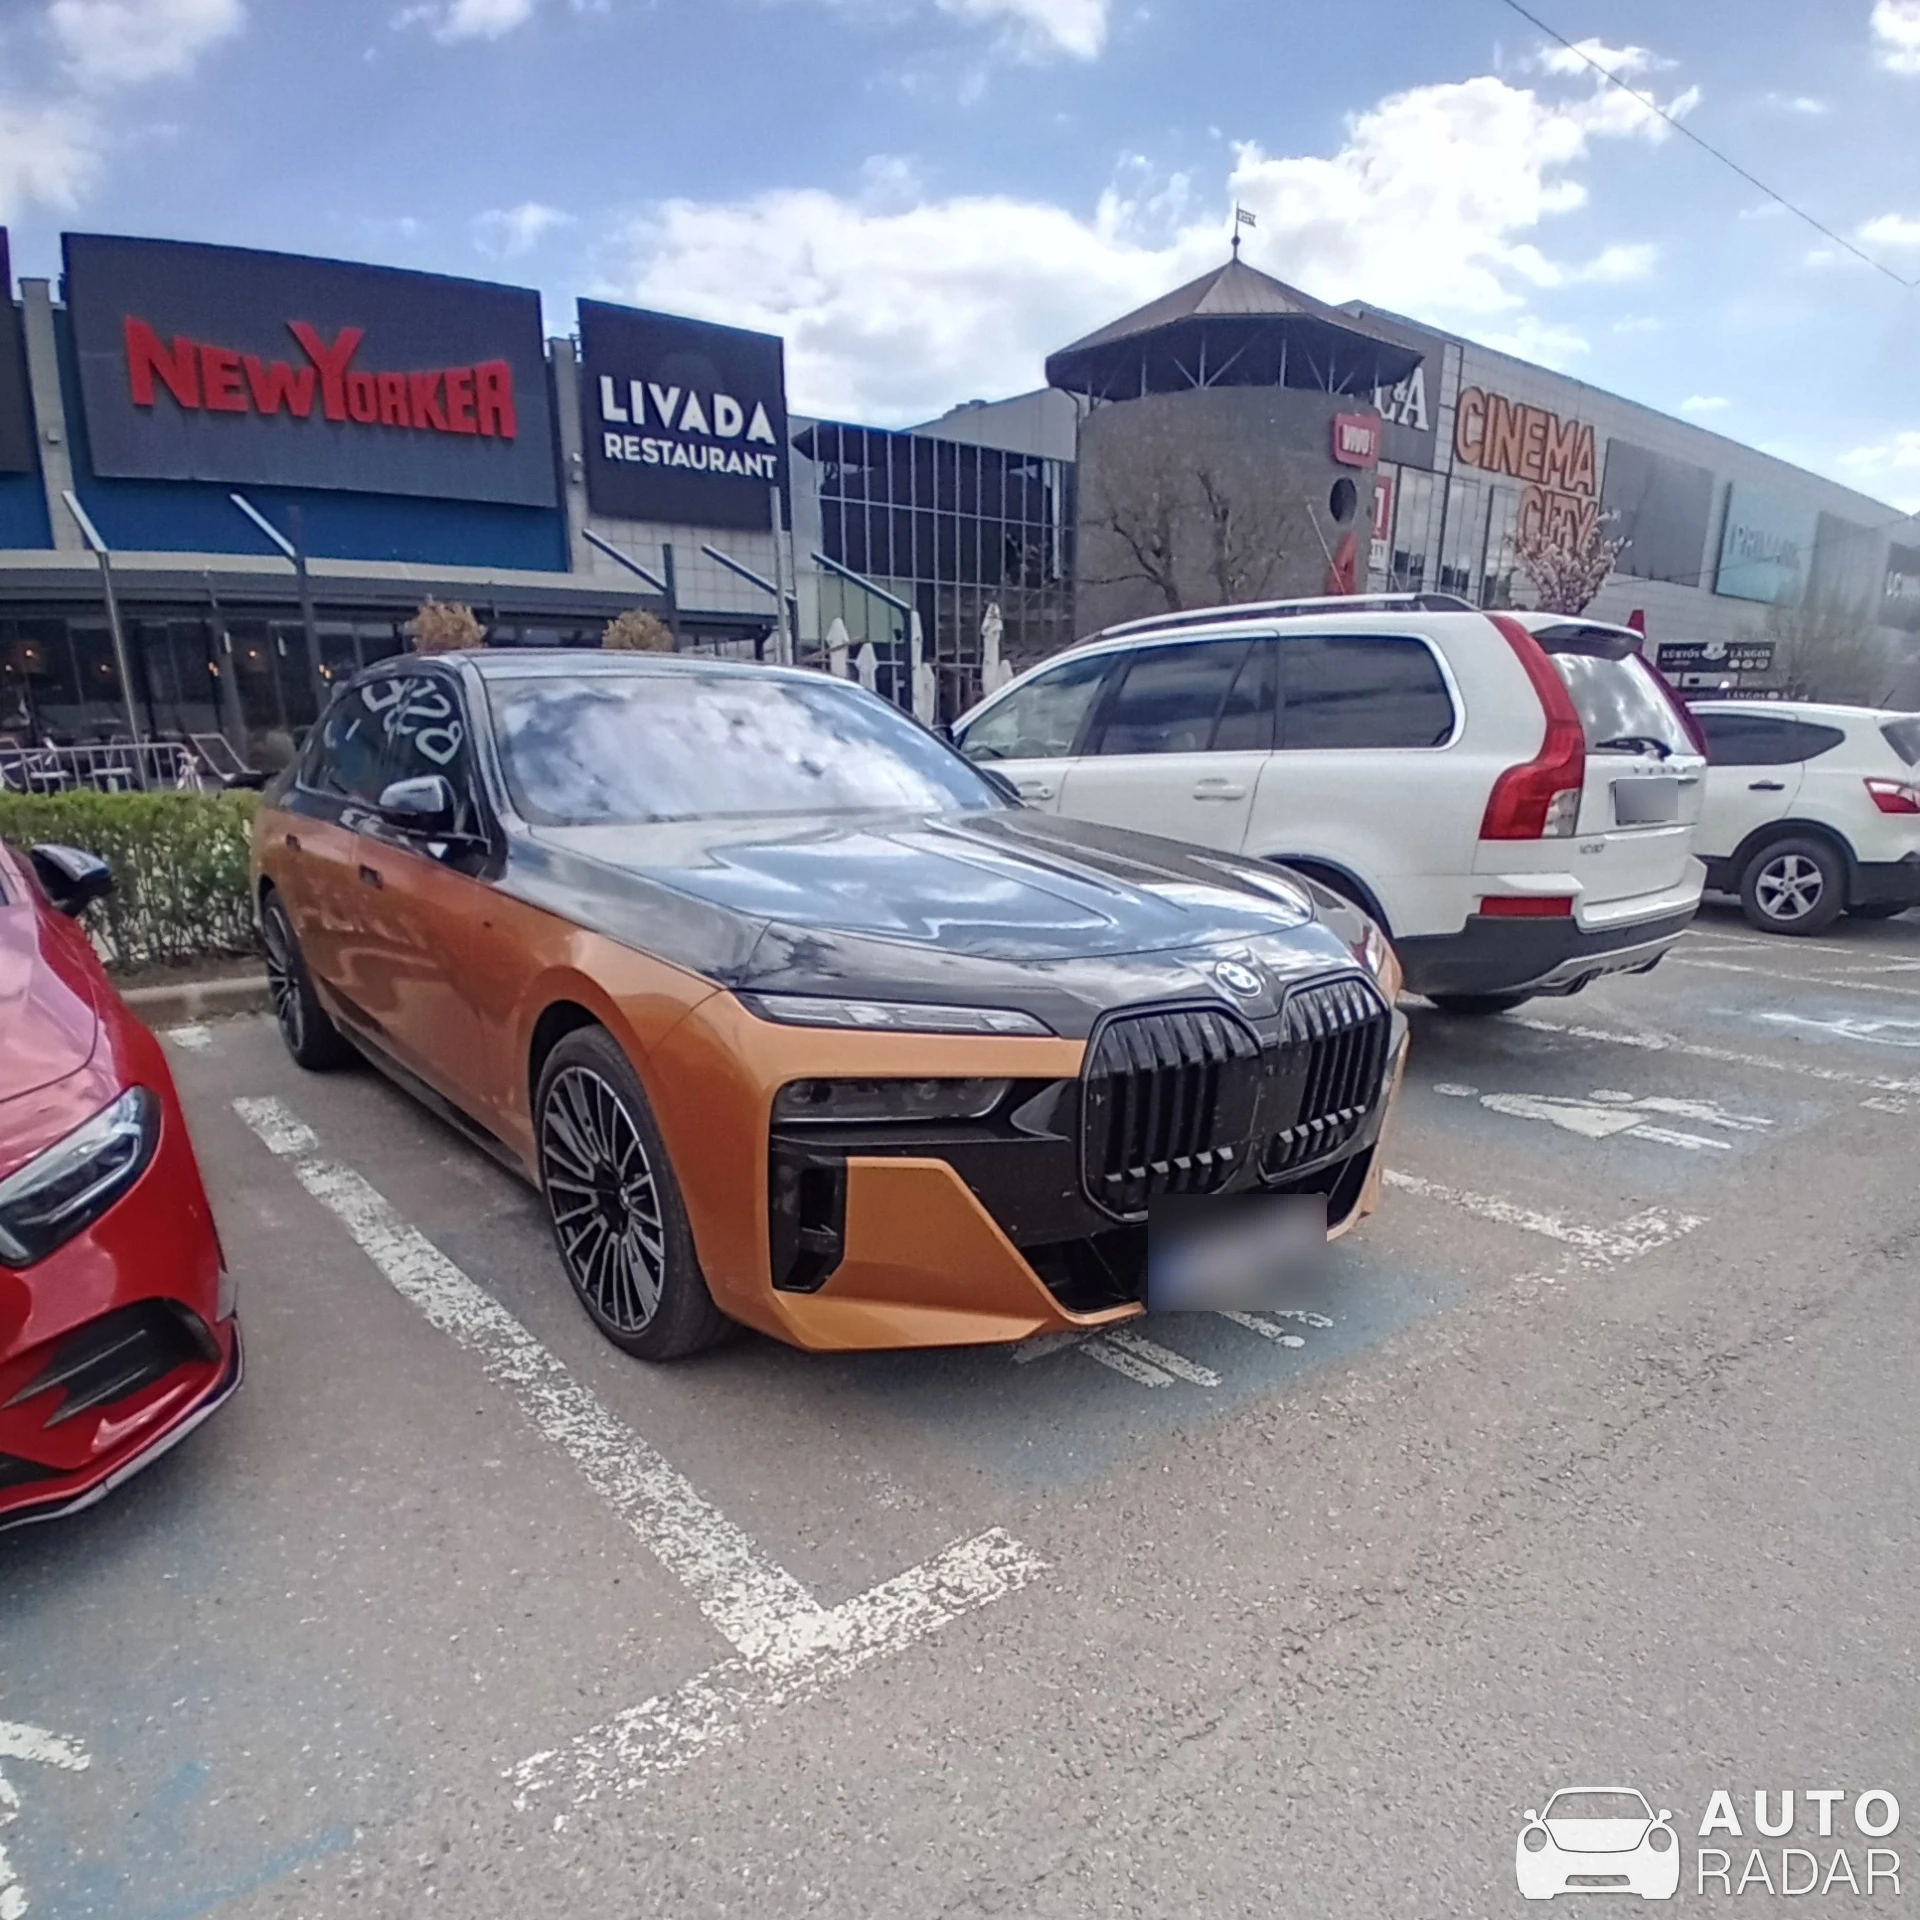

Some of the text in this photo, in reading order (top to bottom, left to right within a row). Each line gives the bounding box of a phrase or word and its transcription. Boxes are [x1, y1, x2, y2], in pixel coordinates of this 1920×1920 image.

[600, 375, 777, 446] LIVADA
[1455, 385, 1596, 496] CINEMA
[603, 431, 778, 479] RESTAURANT
